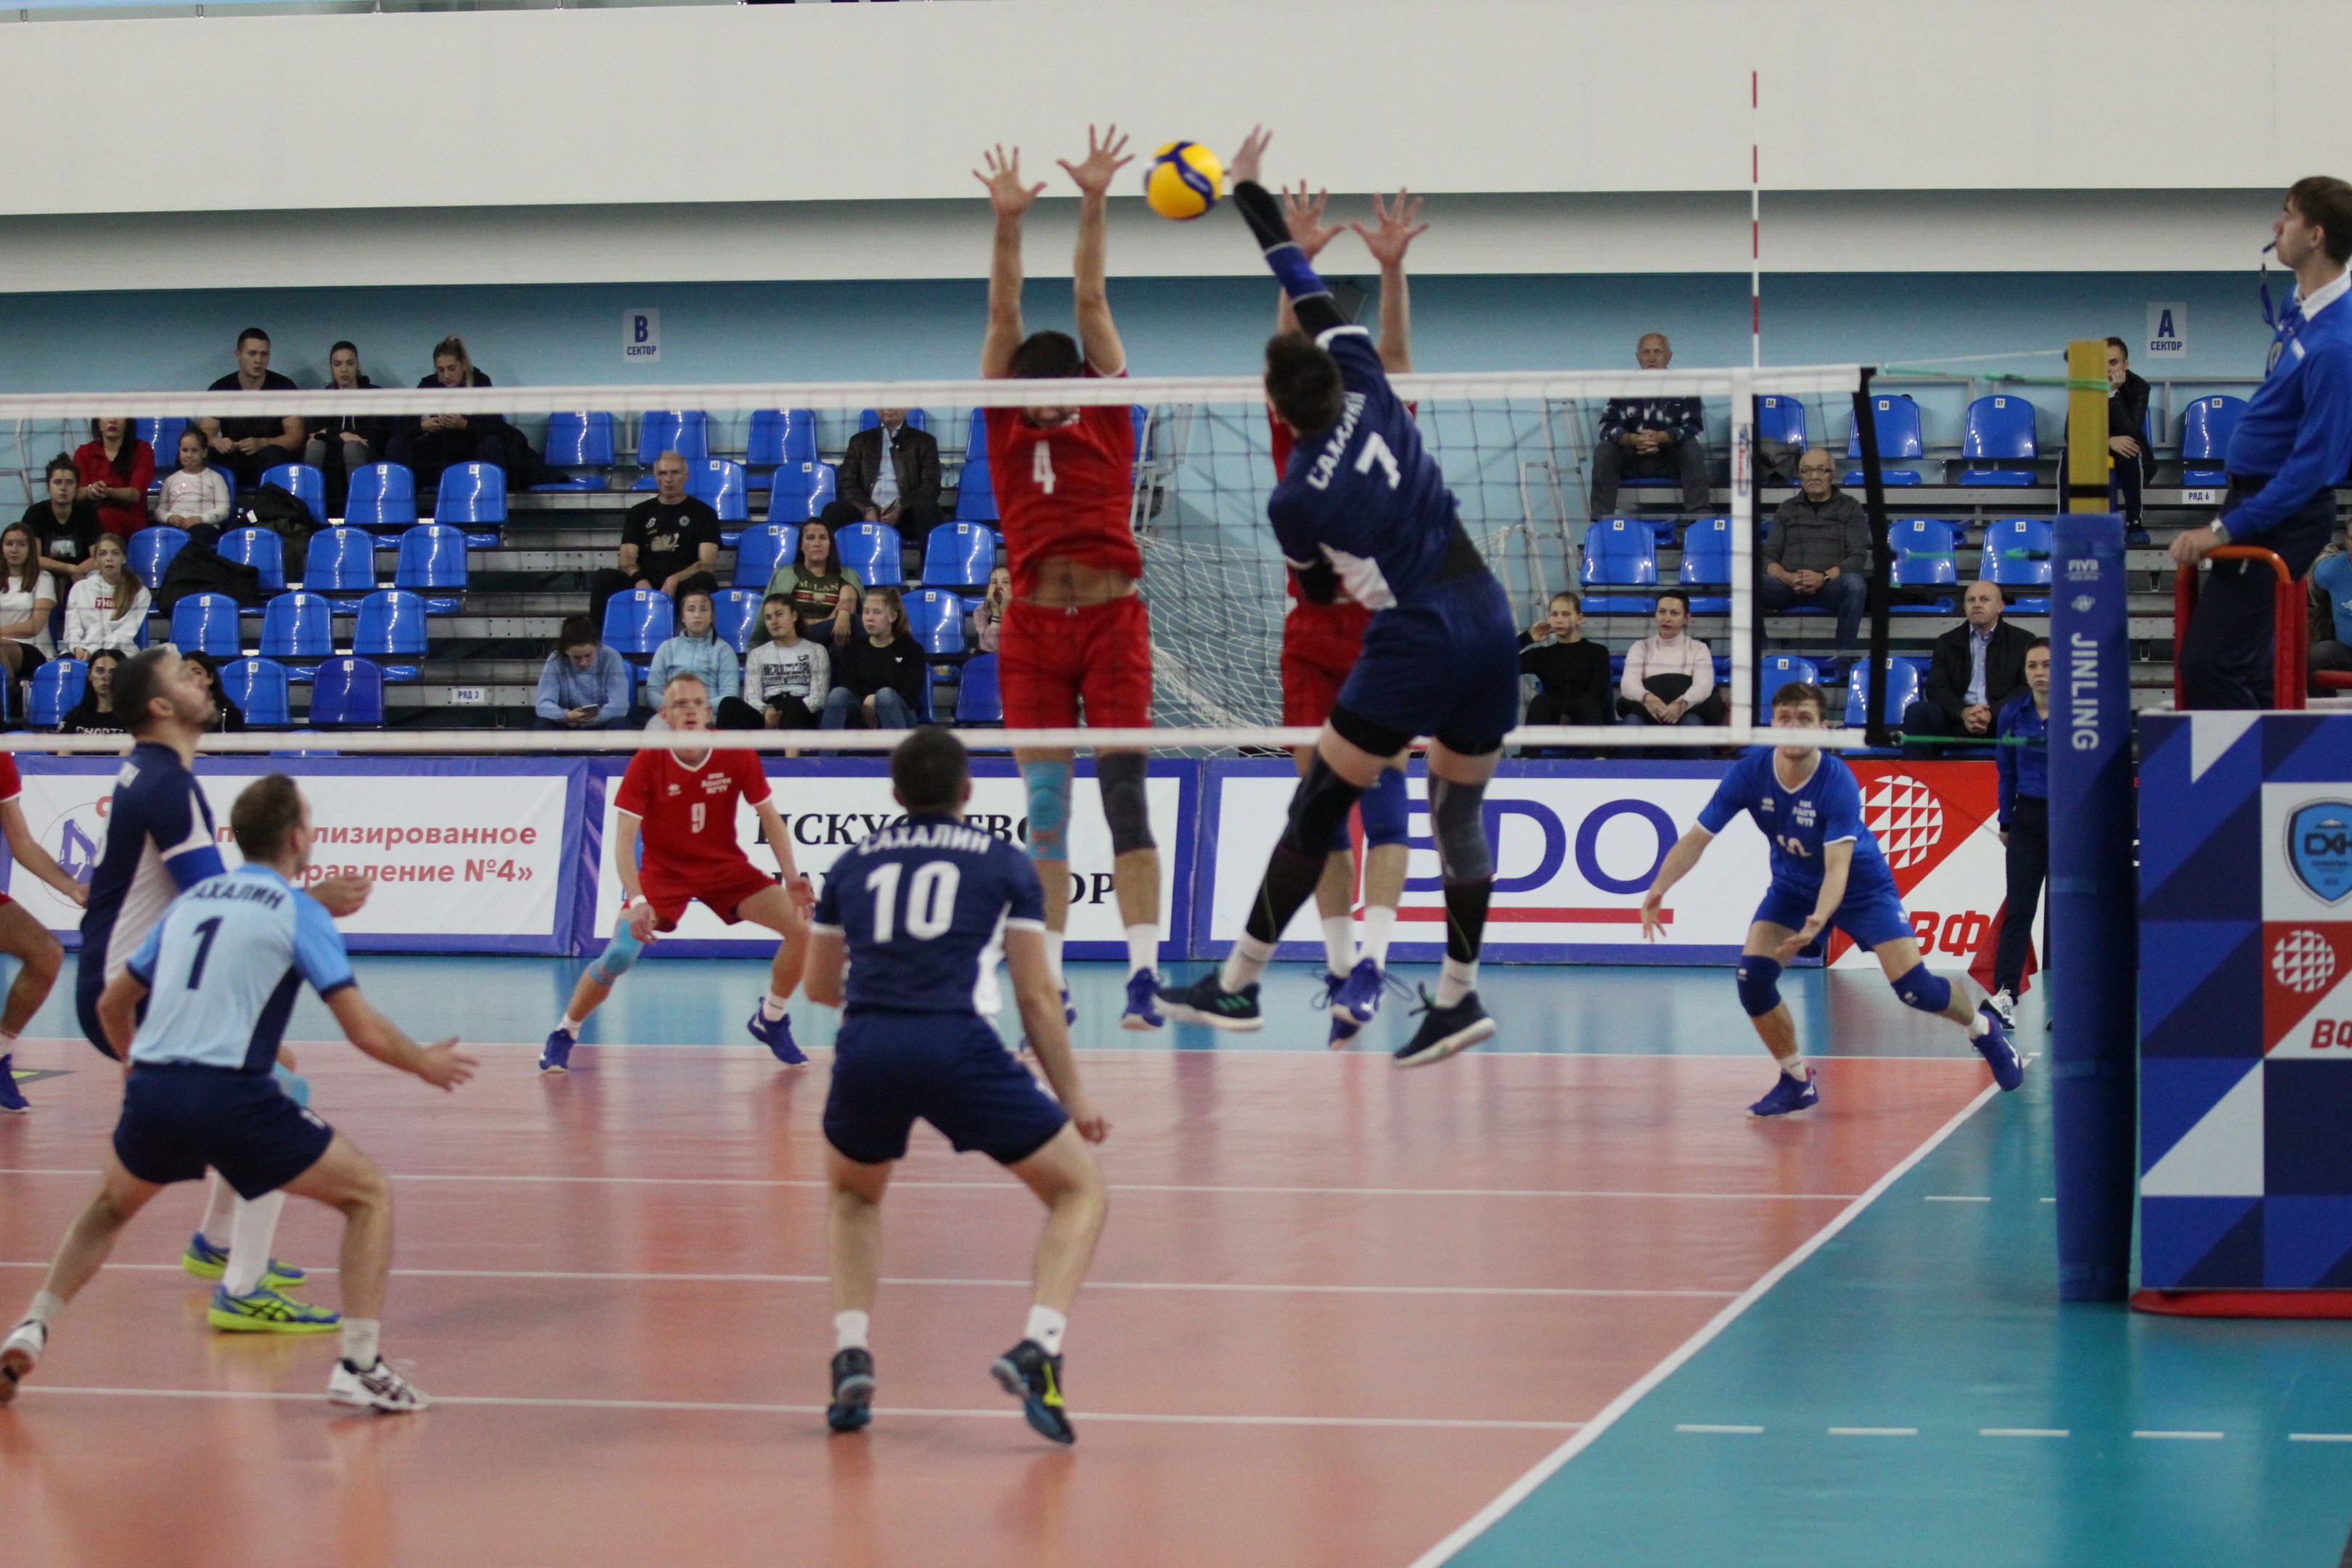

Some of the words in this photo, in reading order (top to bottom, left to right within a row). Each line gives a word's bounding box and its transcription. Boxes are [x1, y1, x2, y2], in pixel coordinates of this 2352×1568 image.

[634, 314, 649, 343] В
[2157, 309, 2176, 338] А
[626, 346, 657, 356] СЕКТОР
[2150, 340, 2183, 351] СЕКТОР
[1033, 440, 1056, 494] 4
[1354, 430, 1402, 490] 7
[2188, 491, 2203, 502] РЯД
[2205, 491, 2210, 500] 6
[458, 690, 473, 700] РЯД
[2070, 632, 2099, 751] JINLING
[690, 802, 706, 834] 9
[295, 864, 455, 890] равление
[190, 882, 285, 909] АХАЛИН
[865, 860, 961, 944] 10
[185, 915, 224, 991] 1
